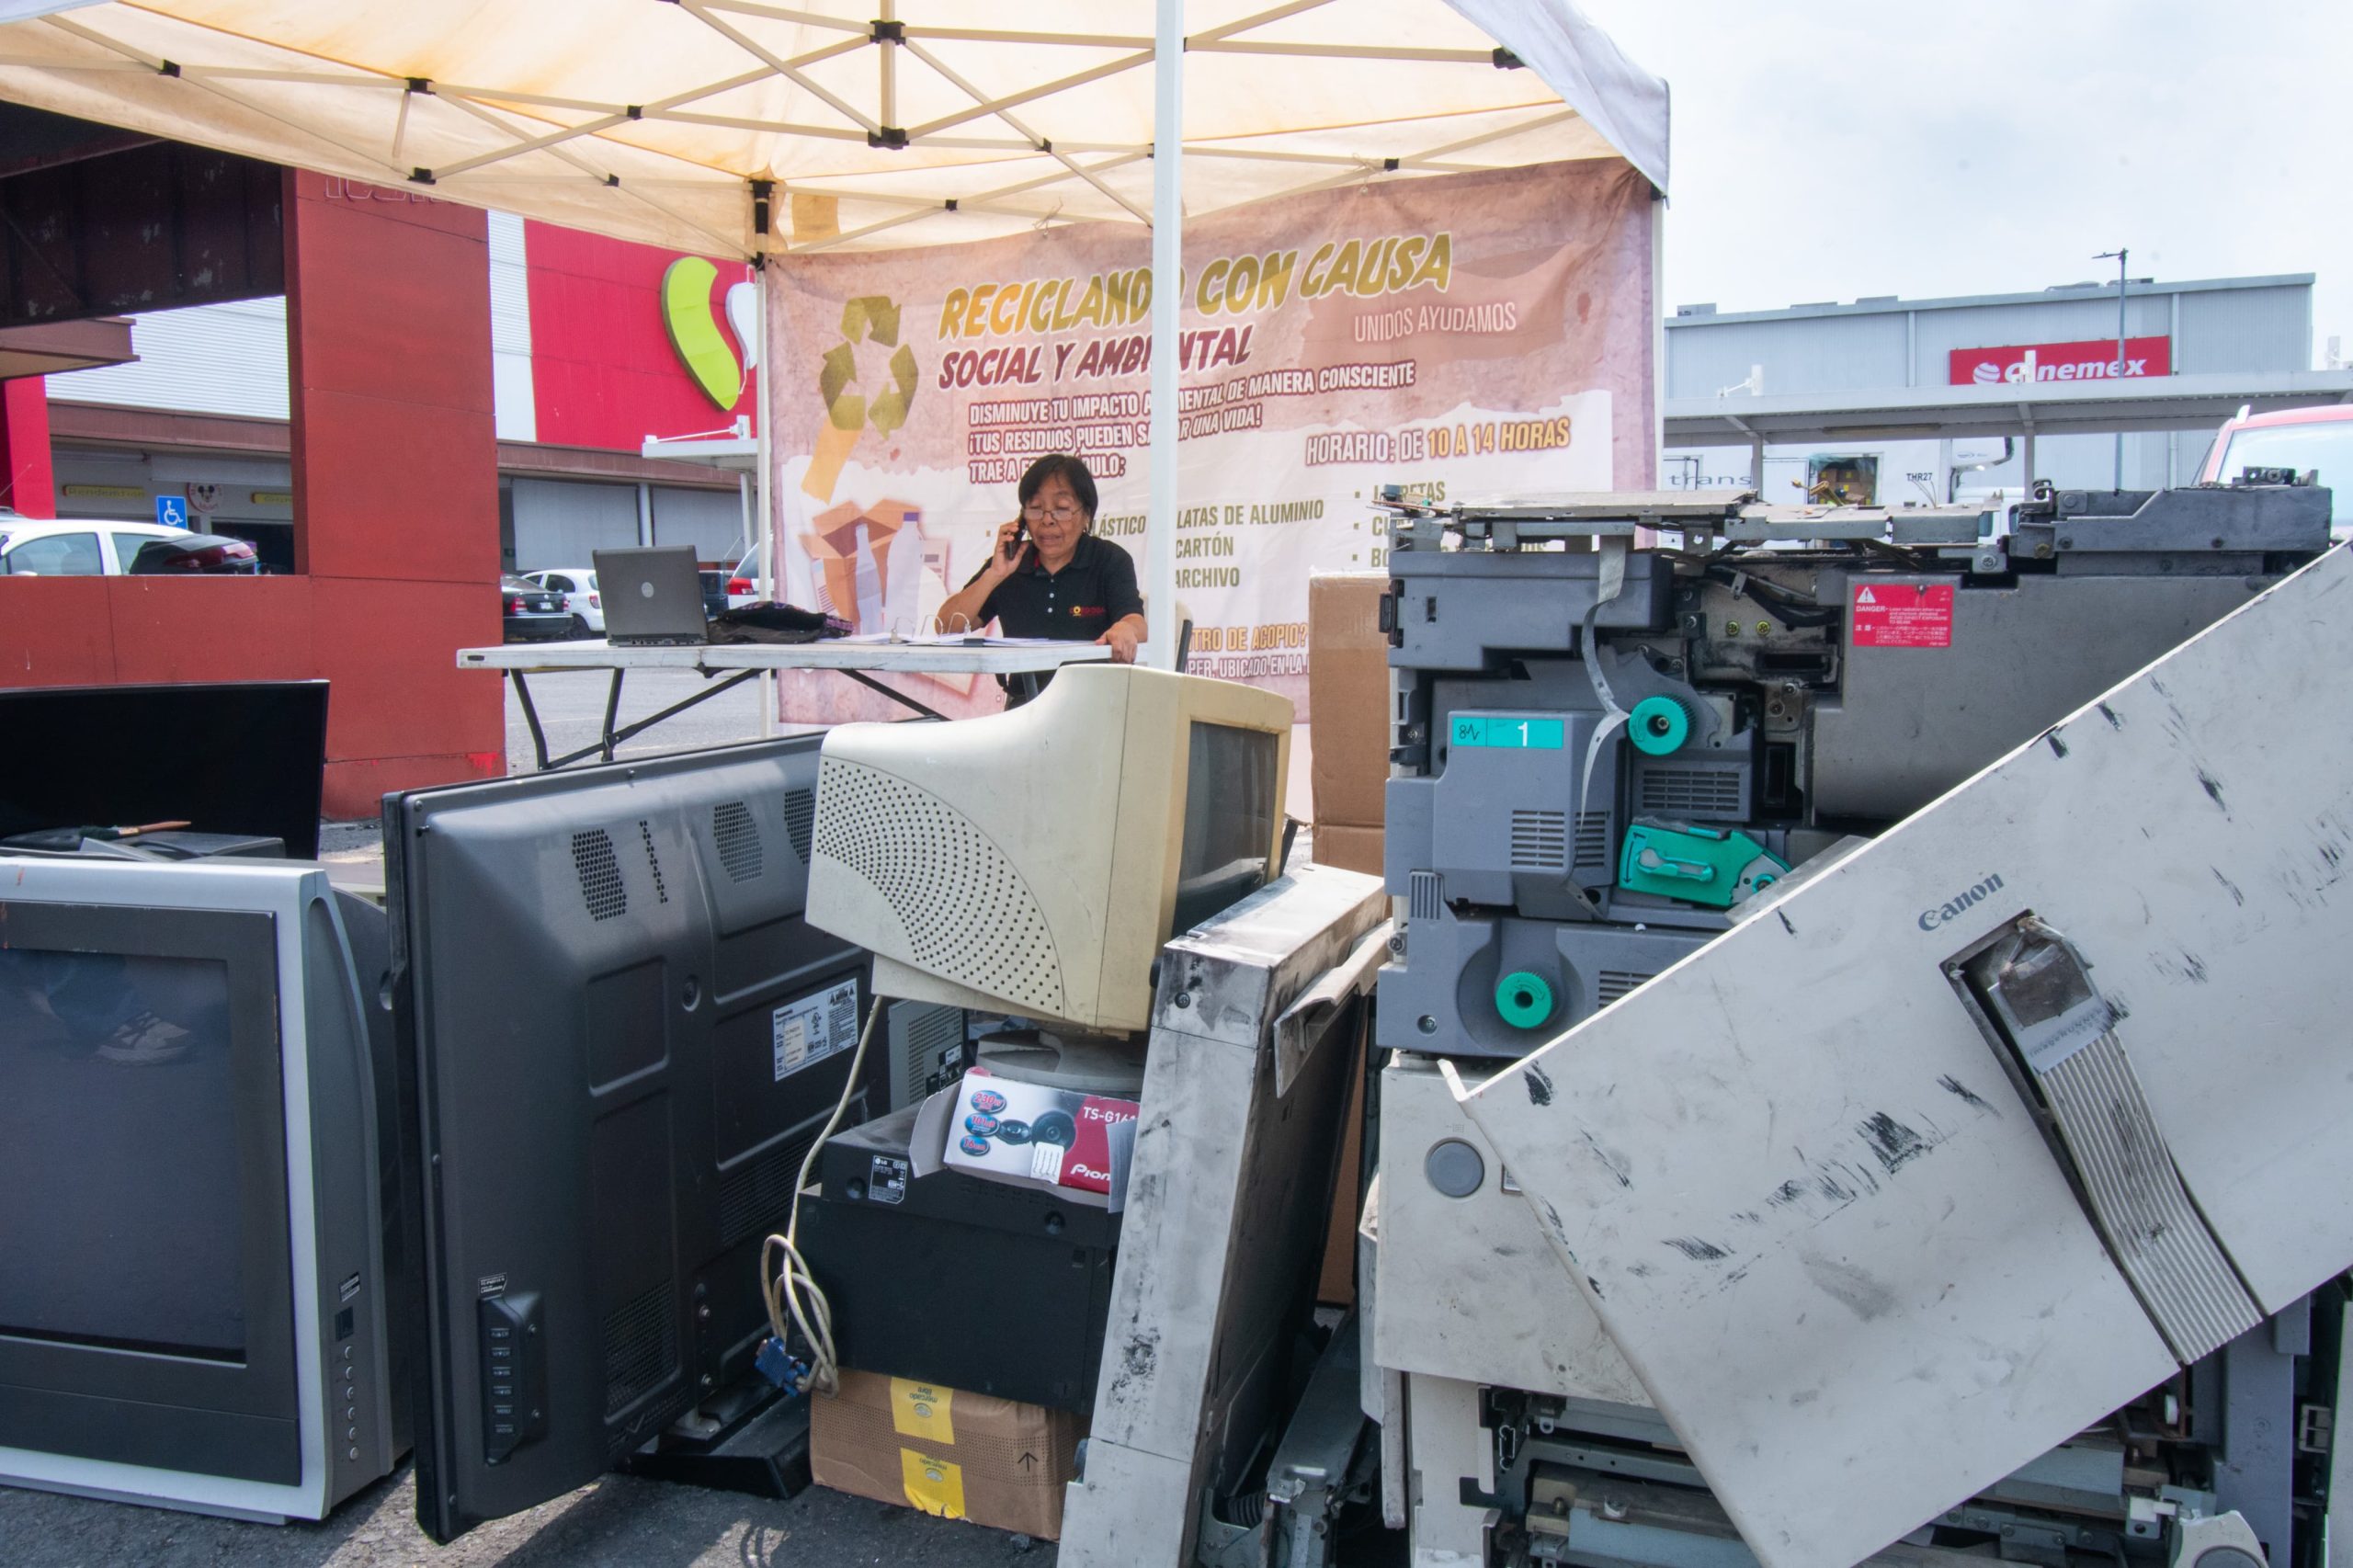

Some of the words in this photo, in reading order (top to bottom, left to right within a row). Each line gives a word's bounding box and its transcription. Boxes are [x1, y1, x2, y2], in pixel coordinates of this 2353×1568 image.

[938, 266, 1186, 341] RECICLAND
[1197, 250, 1299, 315] CON
[1300, 232, 1452, 299] CAUSA
[1354, 308, 1414, 342] UNIDOS
[1417, 301, 1517, 334] AYUDAMOS
[938, 345, 1043, 390] SOCIAL
[1053, 341, 1077, 383] Y
[1074, 324, 1254, 380] AMBINTAL
[2005, 359, 2147, 383] Cnemex
[970, 400, 1049, 425] DISMINUYE
[1051, 397, 1069, 421] TU
[1073, 392, 1139, 420] IMPACTO
[1226, 379, 1246, 402] DE
[1247, 369, 1314, 398] MANERA
[1319, 359, 1415, 391] CONSCIENTE
[1192, 411, 1219, 439] UNA
[1222, 403, 1263, 433] VIDA!
[969, 431, 1001, 455] ¡TUS
[1004, 426, 1074, 453] RESIDUOS
[1075, 422, 1133, 449] PUEDEN
[1306, 431, 1395, 466] HORARIO:
[1400, 429, 1423, 462] DE
[1427, 427, 1450, 459] 10
[1454, 424, 1469, 455] A
[1472, 422, 1495, 454] 14
[1499, 416, 1571, 451] HORAS
[970, 460, 1004, 483] TRAE
[1007, 459, 1018, 482] A
[1906, 472, 1933, 483] THR27
[1091, 514, 1146, 538] LÁSTICO
[1176, 506, 1219, 529] LATAS
[1224, 505, 1245, 526] DE
[1250, 499, 1324, 525] ALUMINIO
[1227, 627, 1247, 652] DE
[1252, 622, 1308, 651] ACOPIO?
[1219, 656, 1268, 679] UBICADO
[1270, 654, 1286, 676] EN
[1289, 653, 1305, 675] LA
[1518, 722, 1529, 747] 1
[1918, 872, 2005, 932] Canon
